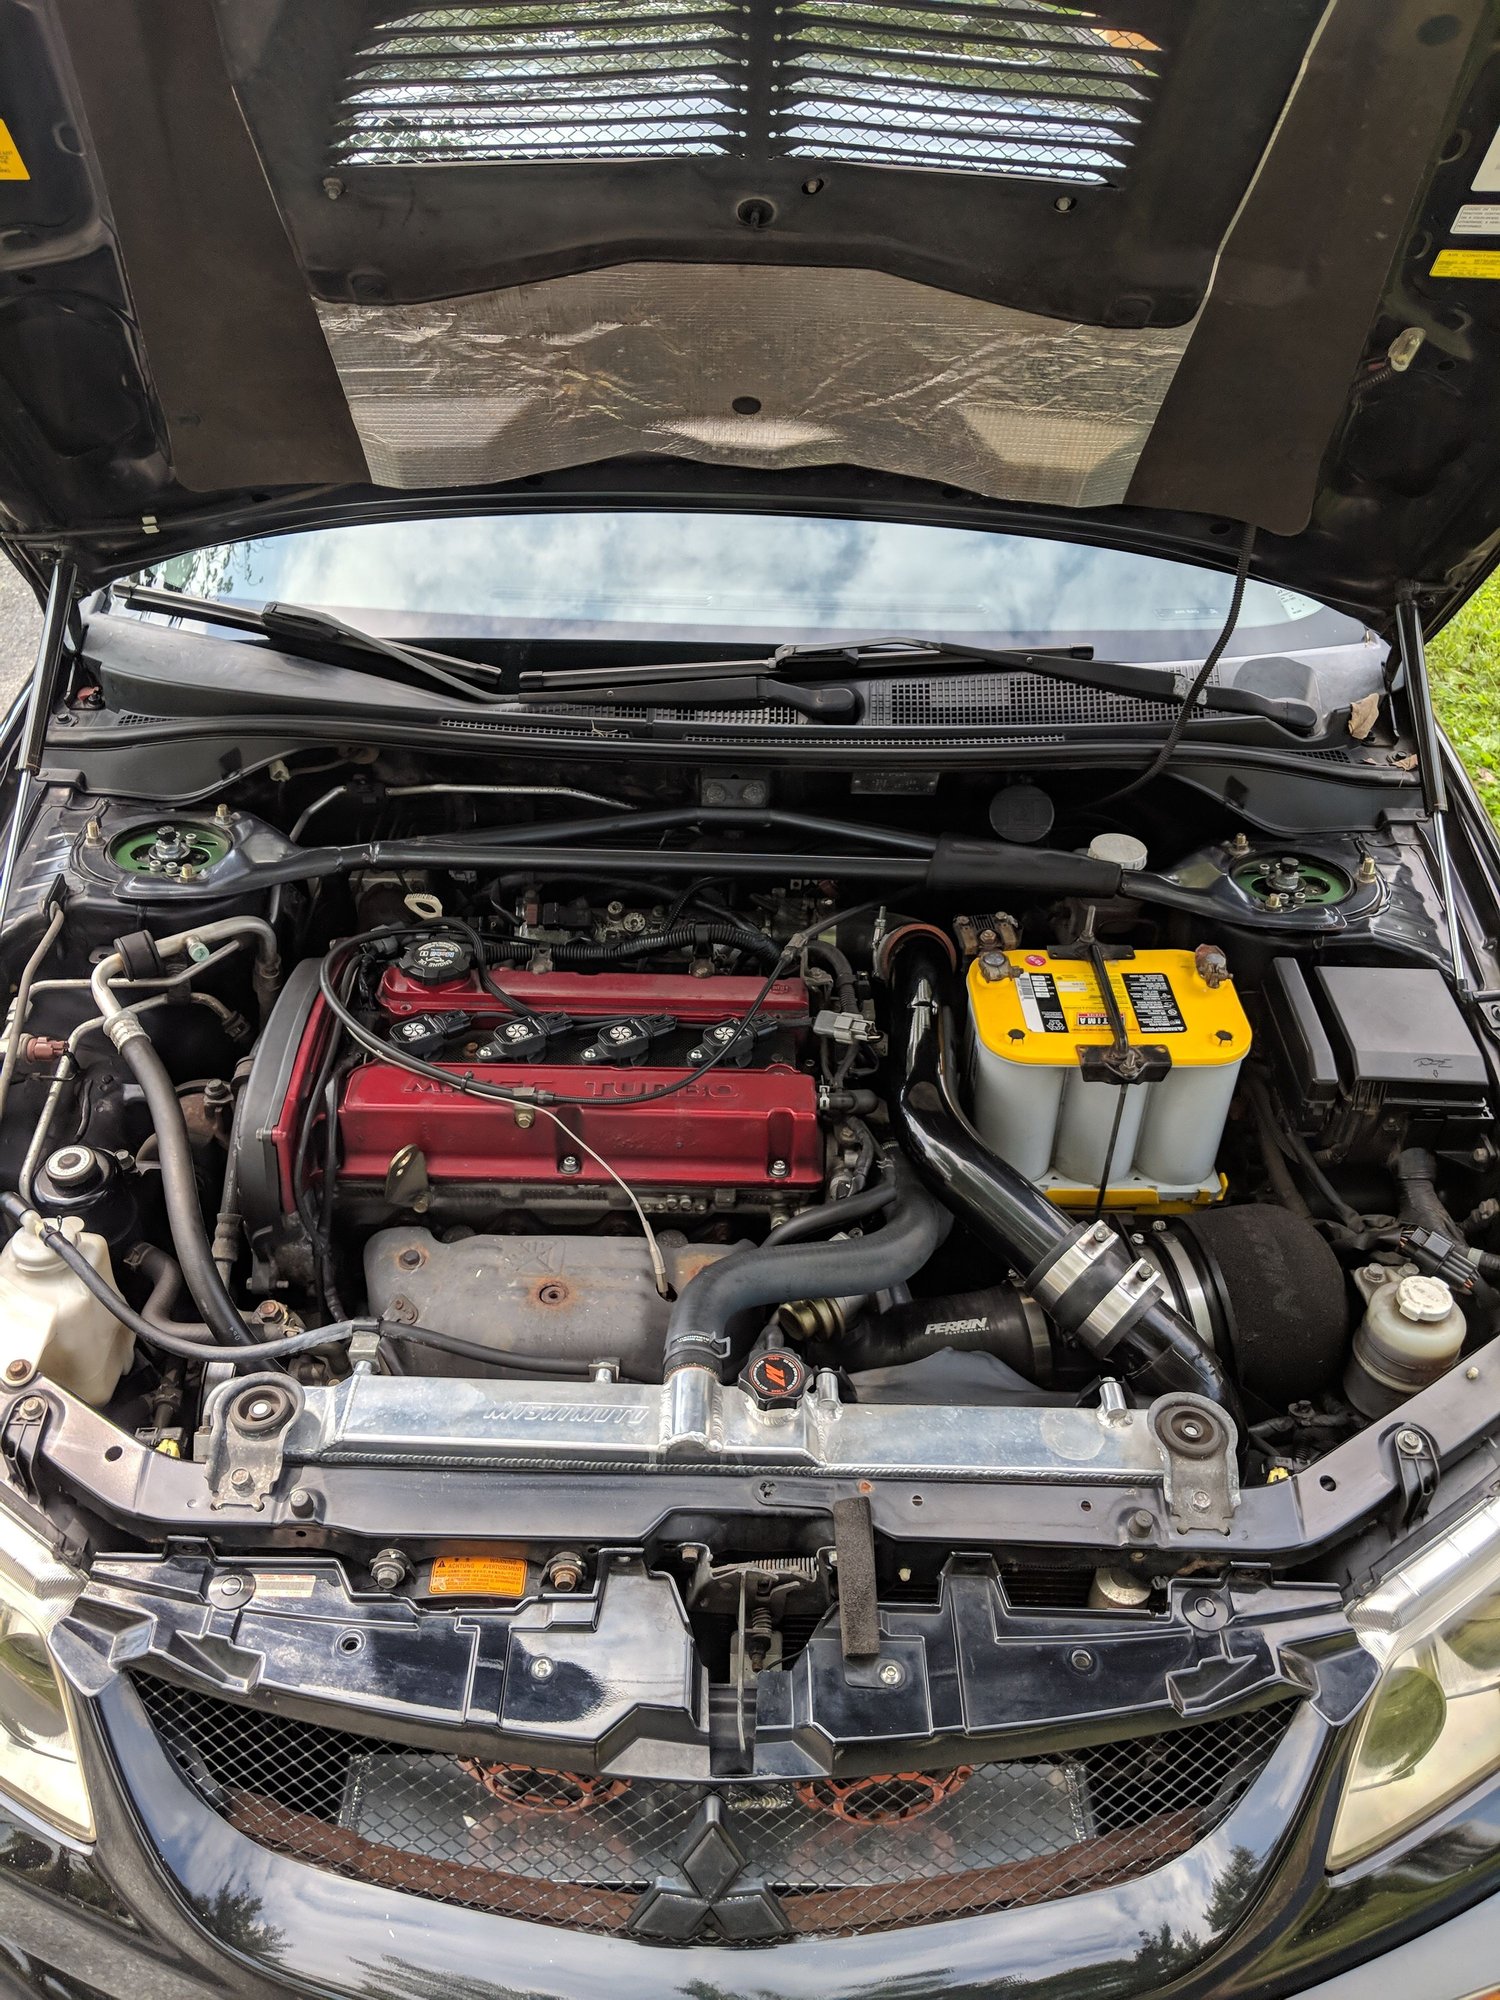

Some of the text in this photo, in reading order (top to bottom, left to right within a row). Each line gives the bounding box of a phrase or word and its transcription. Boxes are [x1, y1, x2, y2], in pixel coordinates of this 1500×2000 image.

[428, 959, 453, 967] ENGINE
[925, 1317, 987, 1335] PERRIN
[483, 1401, 649, 1424] MISHIMOTO
[483, 1563, 522, 1572] AVERTISSEMENT
